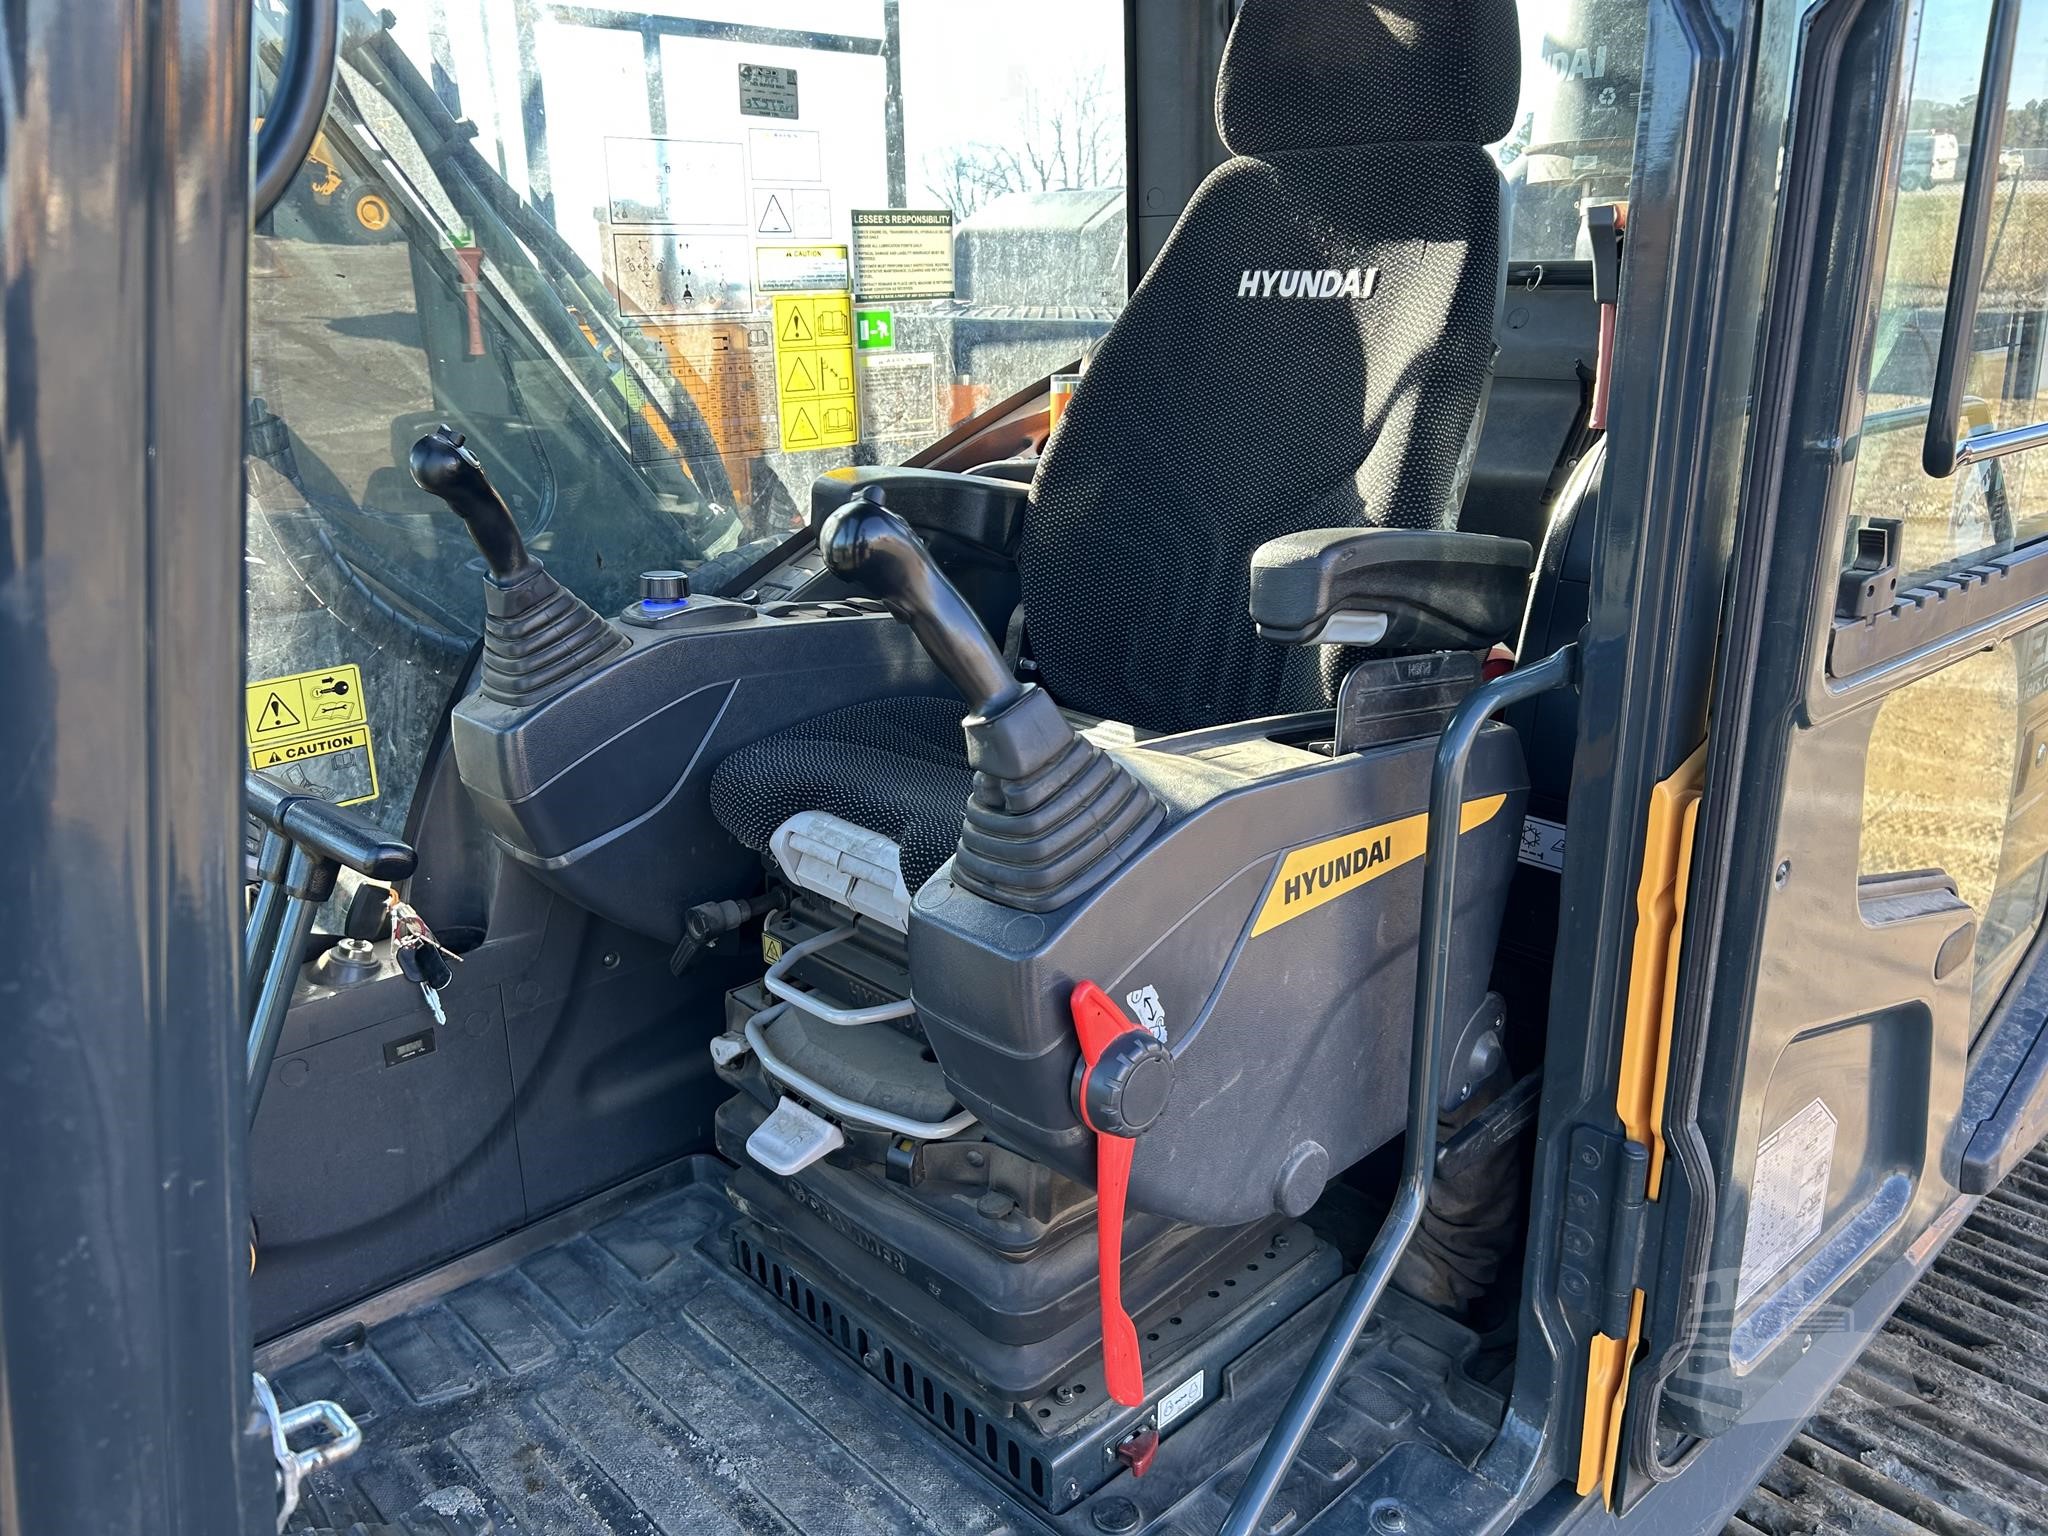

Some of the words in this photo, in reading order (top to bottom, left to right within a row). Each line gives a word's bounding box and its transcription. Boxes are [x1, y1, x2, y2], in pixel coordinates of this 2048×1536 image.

[854, 214, 890, 224] LESSEE'S
[891, 214, 951, 224] RESPONSIBILITY
[1237, 268, 1378, 299] HYUNDAI
[286, 735, 353, 758] CAUTION
[1284, 835, 1391, 905] HYUNDAI
